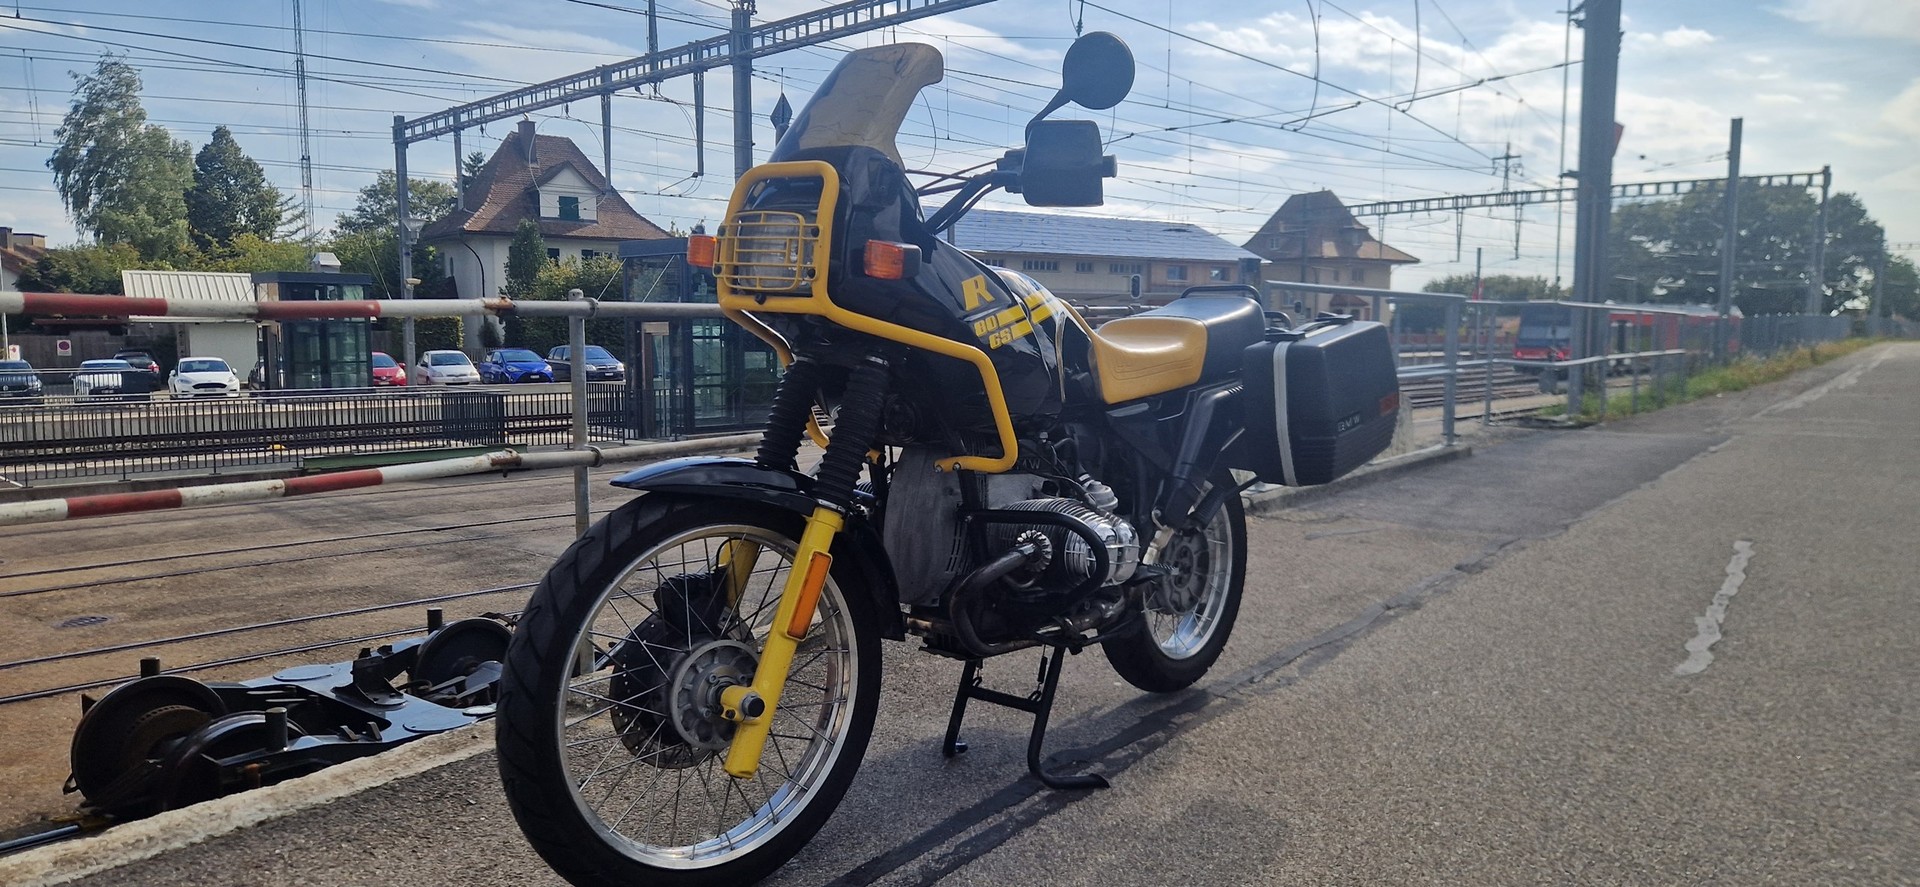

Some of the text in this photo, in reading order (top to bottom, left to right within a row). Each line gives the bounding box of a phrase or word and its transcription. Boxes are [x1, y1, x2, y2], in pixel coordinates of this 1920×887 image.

[961, 274, 996, 311] R
[989, 328, 1012, 350] GS
[1337, 415, 1360, 432] BMW
